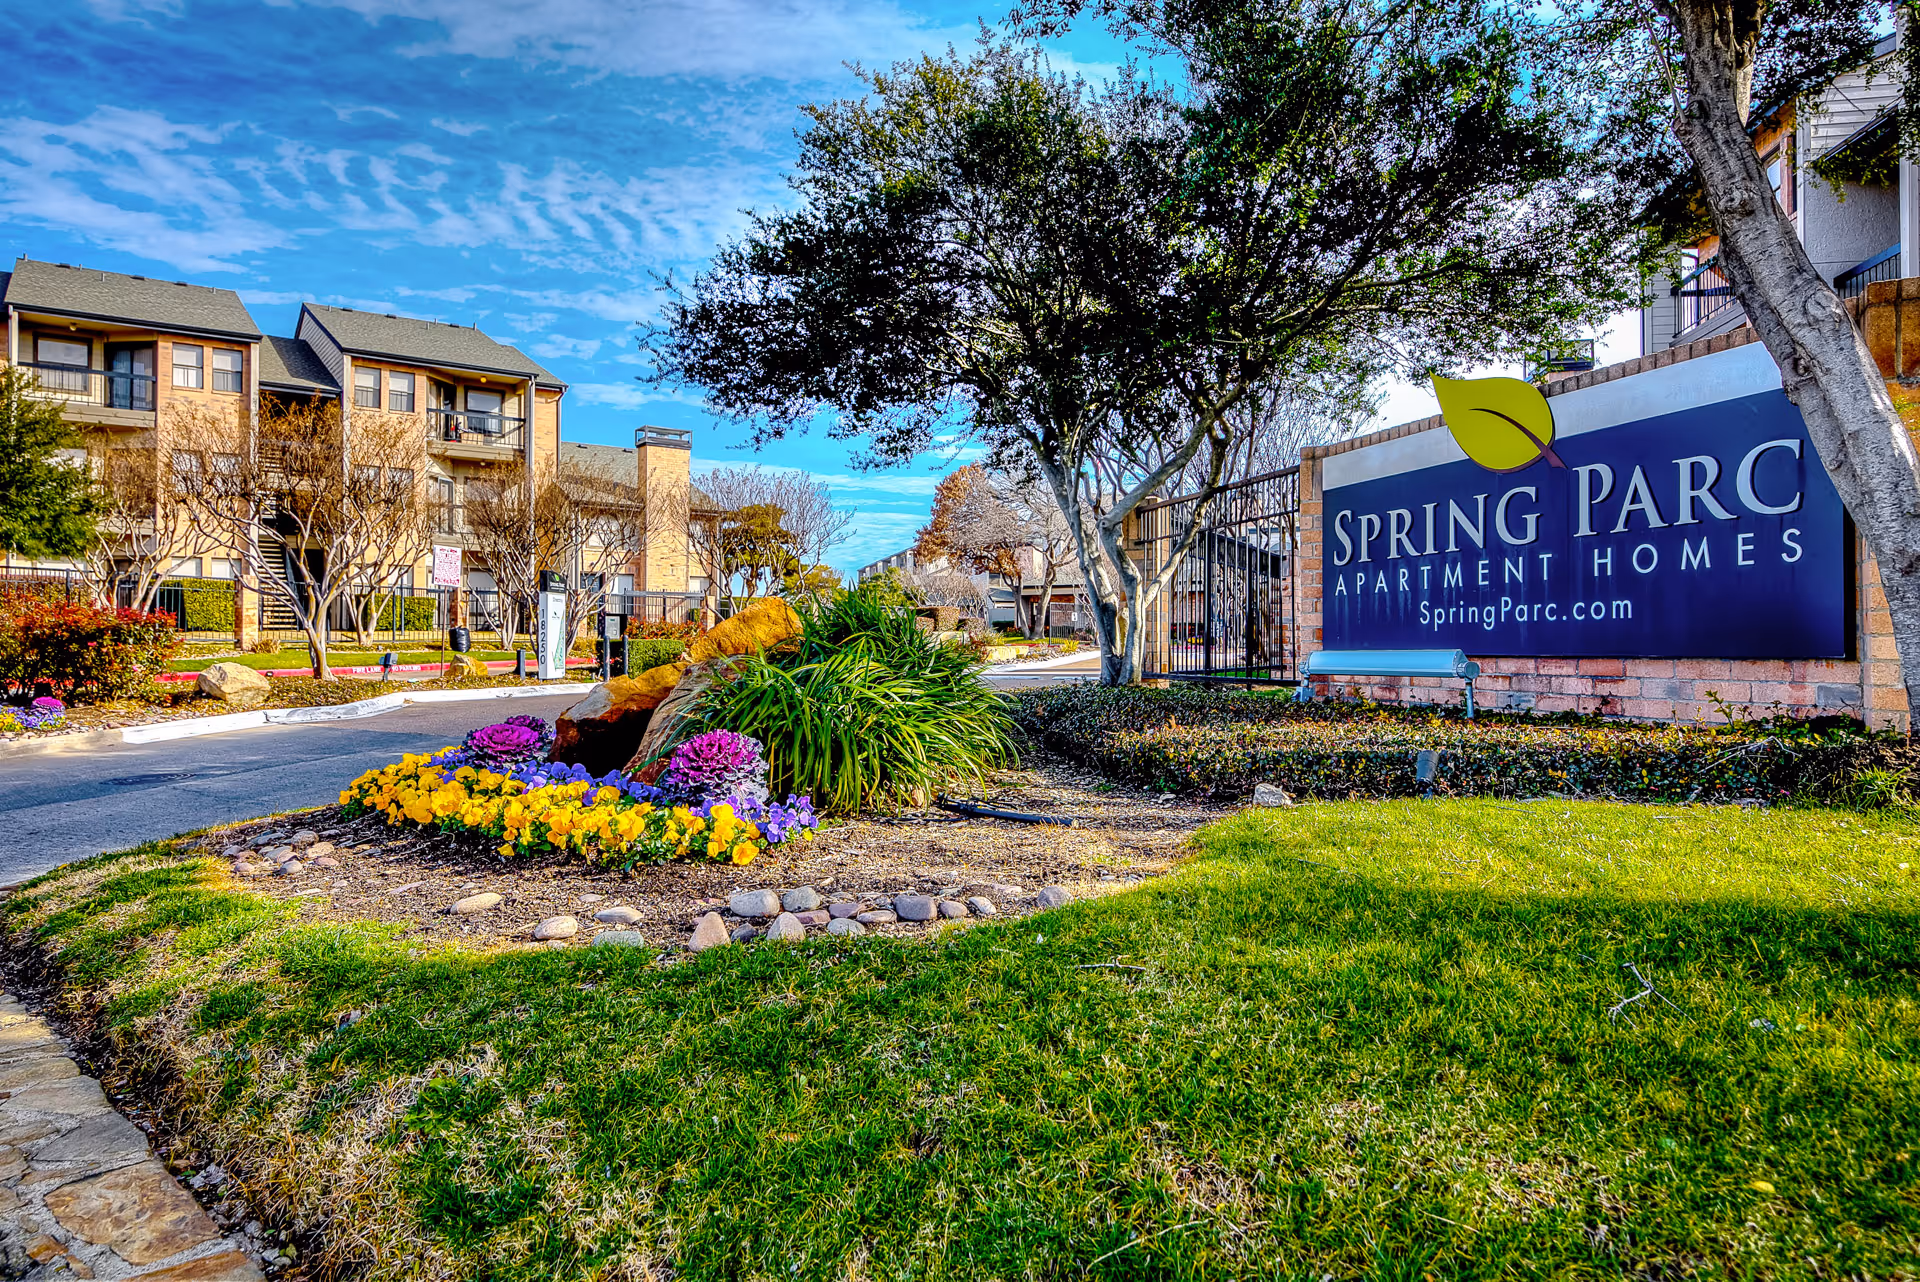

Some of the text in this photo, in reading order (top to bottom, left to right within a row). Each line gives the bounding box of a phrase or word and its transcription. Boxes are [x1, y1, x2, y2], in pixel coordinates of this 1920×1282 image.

[1333, 438, 1804, 566] SPRING PARC
[1335, 528, 1803, 596] APARTMENT HOMES
[1419, 596, 1633, 632] SpringParc.com
